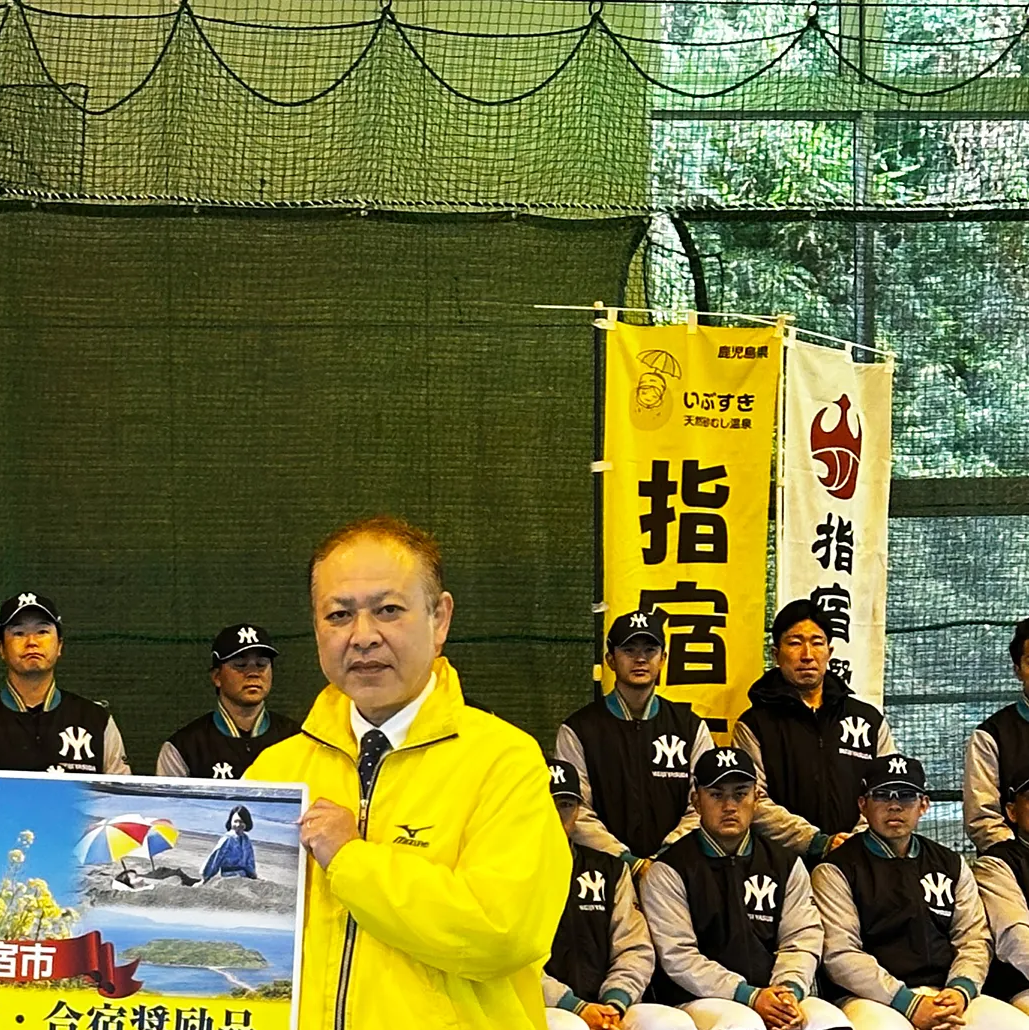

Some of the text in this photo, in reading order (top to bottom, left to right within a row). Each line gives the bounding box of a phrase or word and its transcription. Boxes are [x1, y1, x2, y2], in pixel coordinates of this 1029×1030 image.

[717, 345, 768, 359] 鹿児島県
[683, 392, 755, 412] いぶすき
[638, 460, 729, 732] 指宿
